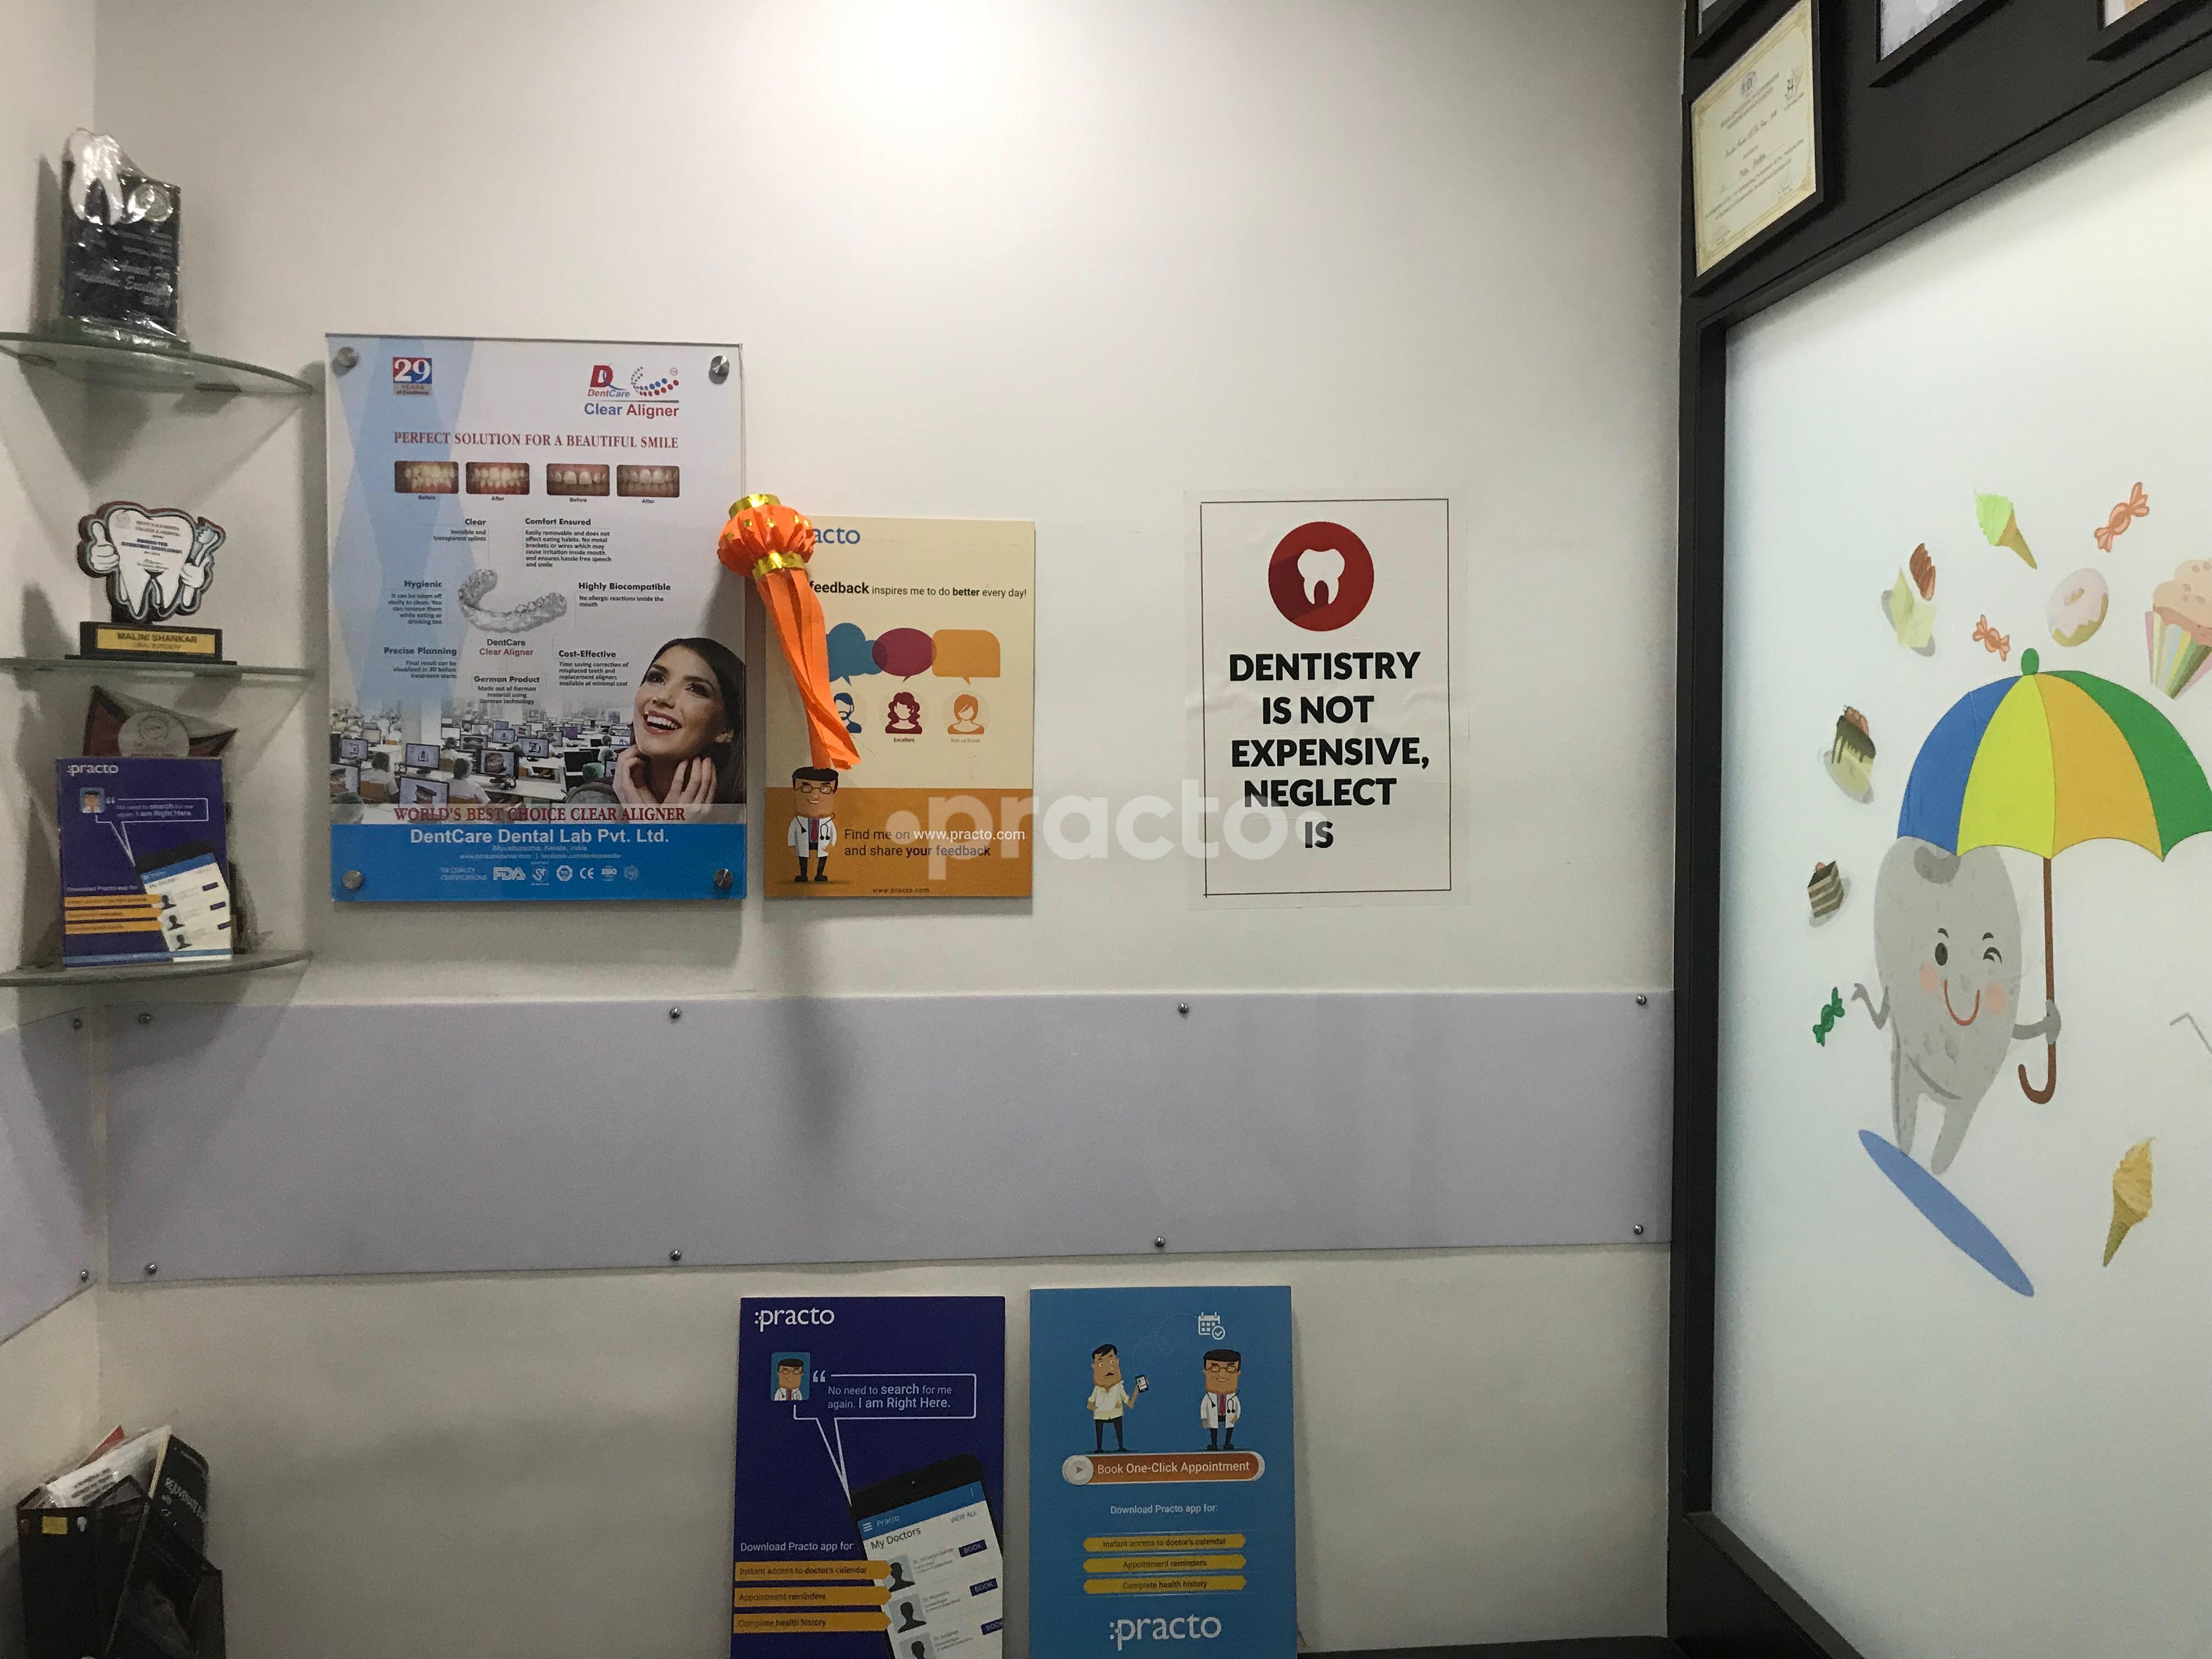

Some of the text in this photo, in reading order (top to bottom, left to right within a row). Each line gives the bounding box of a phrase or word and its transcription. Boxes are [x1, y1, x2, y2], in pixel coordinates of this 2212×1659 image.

[395, 359, 431, 382] 29
[587, 389, 630, 397] DentCare
[584, 403, 679, 419] Clear Aligner
[394, 432, 678, 448] PERFECT SOLUTION FOR A BEAUTIFUL SMILE
[557, 542, 573, 550] wires
[404, 580, 442, 589] Hygienic
[579, 582, 670, 592] Highly Biocompatible
[872, 585, 907, 596] inspires
[939, 587, 950, 595] do
[952, 587, 980, 596] better
[982, 590, 1006, 599] every
[1008, 588, 1026, 599] day!
[152, 634, 197, 643] SHANKAR
[416, 647, 456, 656] Planning
[503, 648, 533, 656] Aligner
[1229, 651, 1420, 681] DENTISTRY
[1263, 695, 1374, 725] IS NOT
[1232, 737, 1429, 769] EXPENSIVE,
[1244, 777, 1397, 808] NEGLECT
[393, 807, 685, 822] WORLD'S BEST CHOICE CLEAR ALIGNER
[411, 828, 668, 843] DentCare Dental Lab Pvt. Ltd.
[845, 828, 869, 839] Find
[873, 831, 891, 840] me
[914, 830, 1025, 842] www.practo.com
[1305, 821, 1333, 848] IS
[844, 844, 991, 859] and share your feedback
[493, 867, 526, 880] FDA
[828, 1386, 841, 1395] No
[844, 1385, 866, 1394] need
[881, 1383, 919, 1394] search
[922, 1385, 935, 1393] for
[828, 1397, 950, 1410] again. I am Right Here.
[1098, 1461, 1249, 1475] Book One-Click Appointment
[1110, 1504, 1153, 1514] Download
[1186, 1505, 1201, 1514] app
[877, 1515, 900, 1528] Practo
[950, 1514, 965, 1523] VIEW
[871, 1527, 921, 1550] My Doctors
[1103, 1539, 1128, 1548] Instant
[1165, 1538, 1194, 1548] doctor's
[741, 1542, 786, 1551] Download
[788, 1542, 817, 1551] Practo
[820, 1543, 837, 1552] app
[963, 1543, 982, 1554] BOOK
[836, 1566, 867, 1574] calendar
[1123, 1559, 1207, 1569] Appointment reminders
[1122, 1580, 1207, 1590] Complete health history
[739, 1592, 826, 1602] Appointment reminders
[738, 1618, 826, 1628] Complete health history
